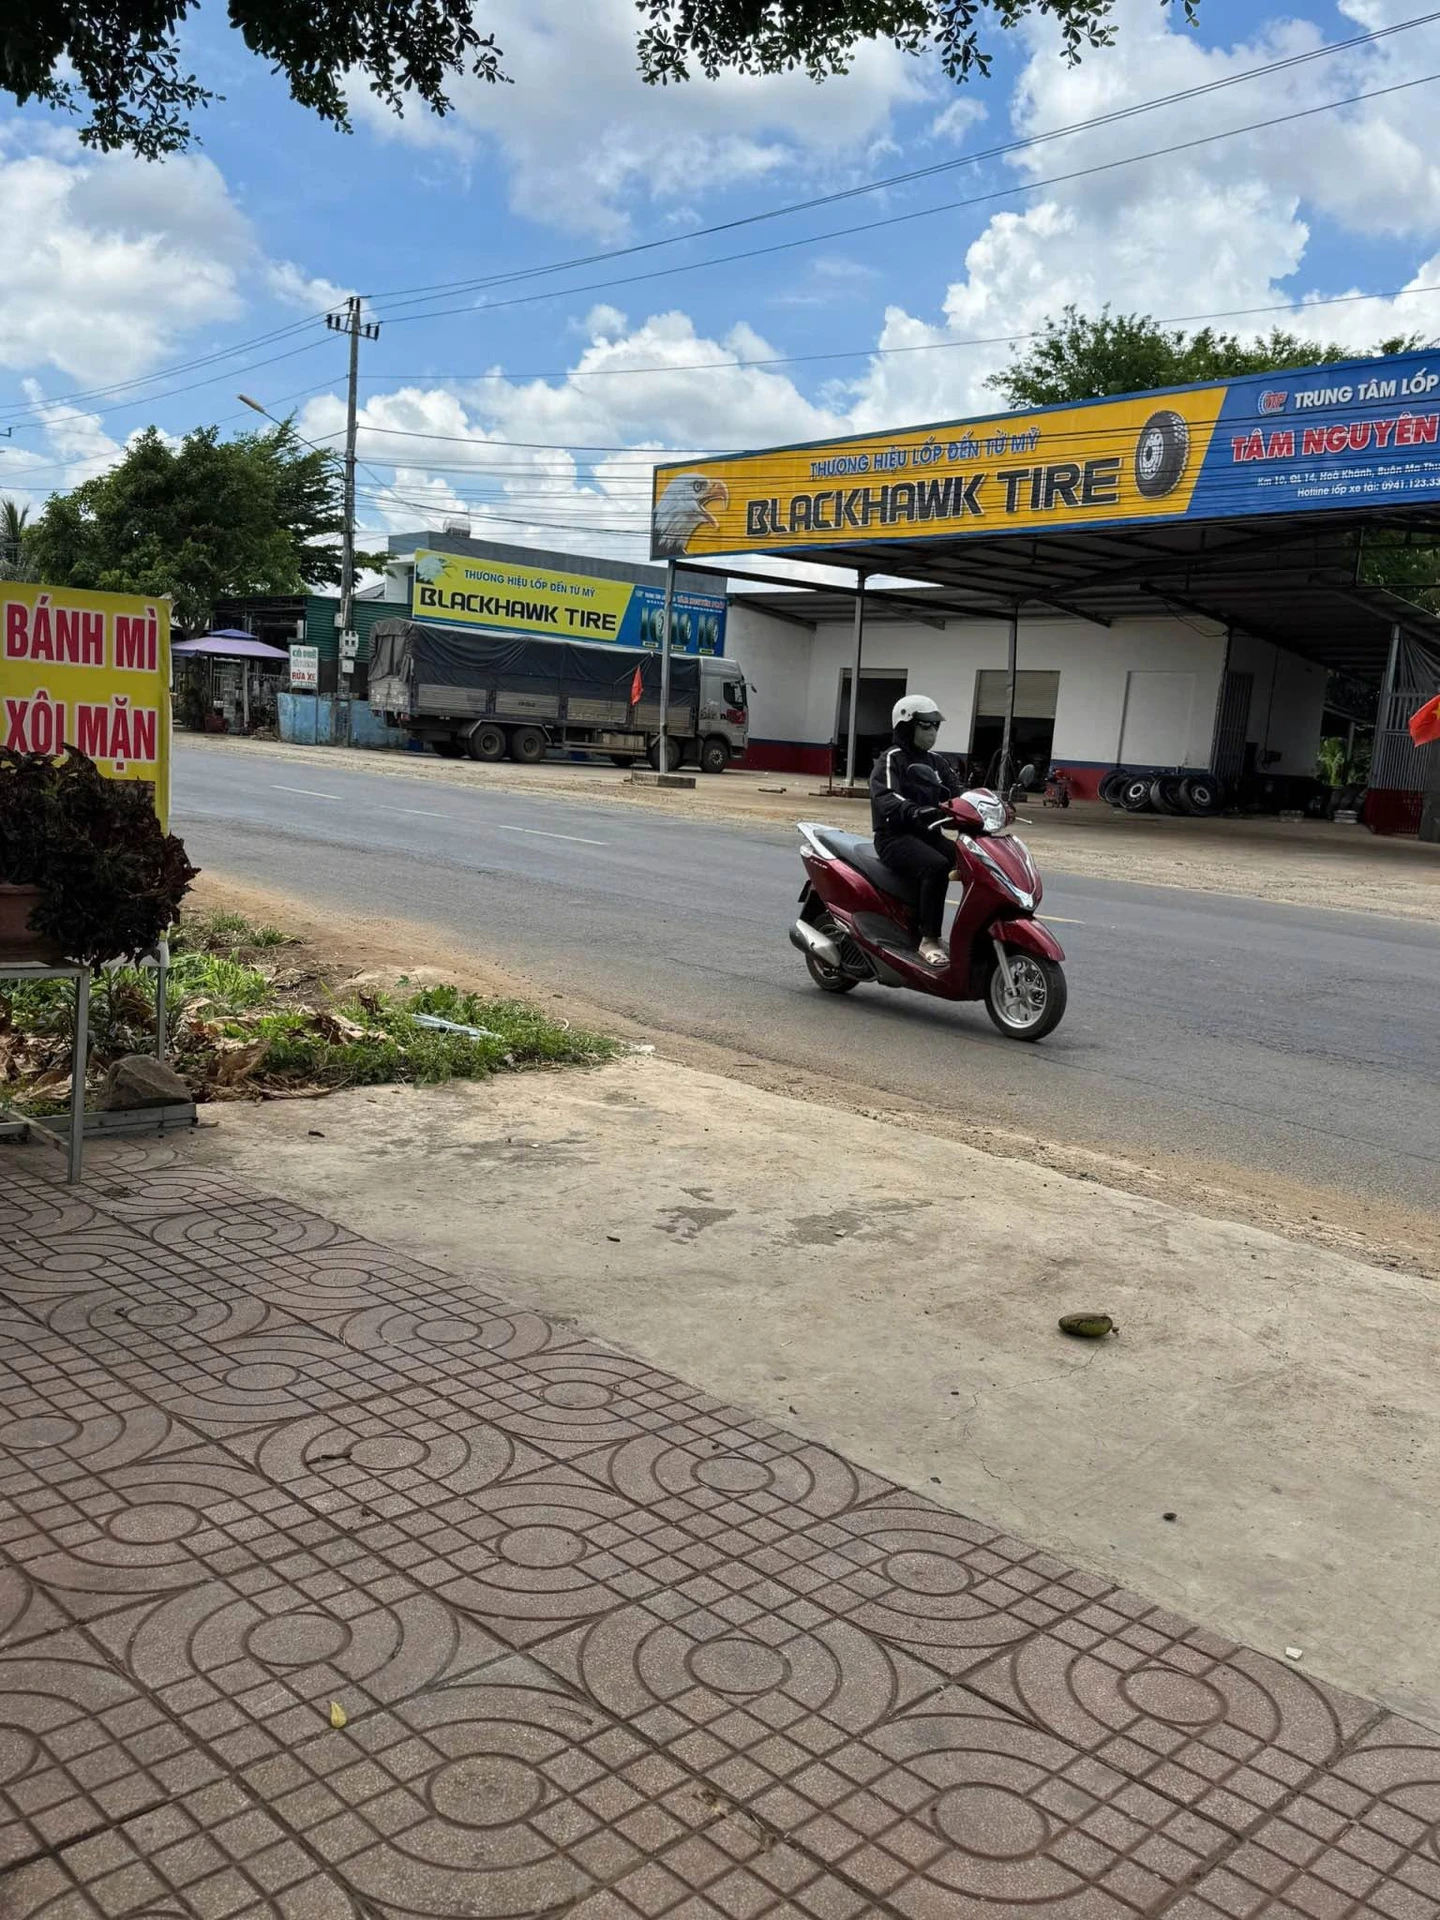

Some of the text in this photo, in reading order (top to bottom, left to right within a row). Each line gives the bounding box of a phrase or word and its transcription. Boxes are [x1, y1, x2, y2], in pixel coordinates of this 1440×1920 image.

[1295, 367, 1439, 409] TRUNG TÂM LỐP
[912, 436, 942, 465] LỐP
[947, 428, 980, 461] ĐẾN
[1231, 411, 1440, 462] TÂM NGUYÊN
[746, 458, 1122, 537] BLACKHAWK TIRE
[531, 576, 548, 590] LỐP
[7, 595, 157, 670] BÁNH MÌ
[420, 587, 617, 632] BLACKHAWK TIRE
[6, 690, 156, 770] XÔI MẶN
